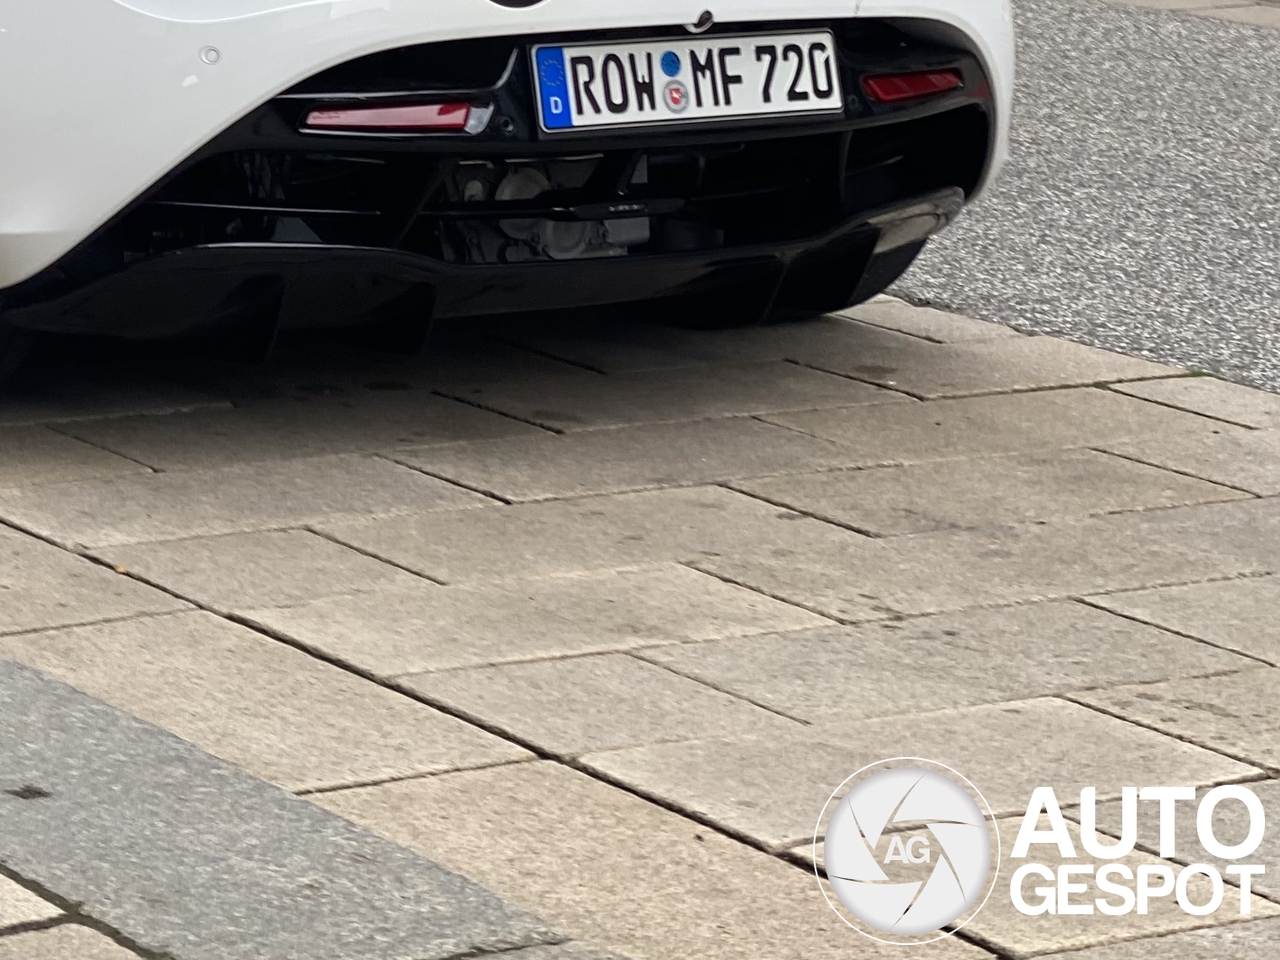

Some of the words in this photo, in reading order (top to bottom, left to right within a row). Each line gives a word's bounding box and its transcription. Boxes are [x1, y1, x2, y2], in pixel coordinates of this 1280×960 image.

[549, 96, 563, 114] D
[571, 52, 656, 115] ROW
[689, 46, 742, 107] MF
[754, 42, 834, 103] 720
